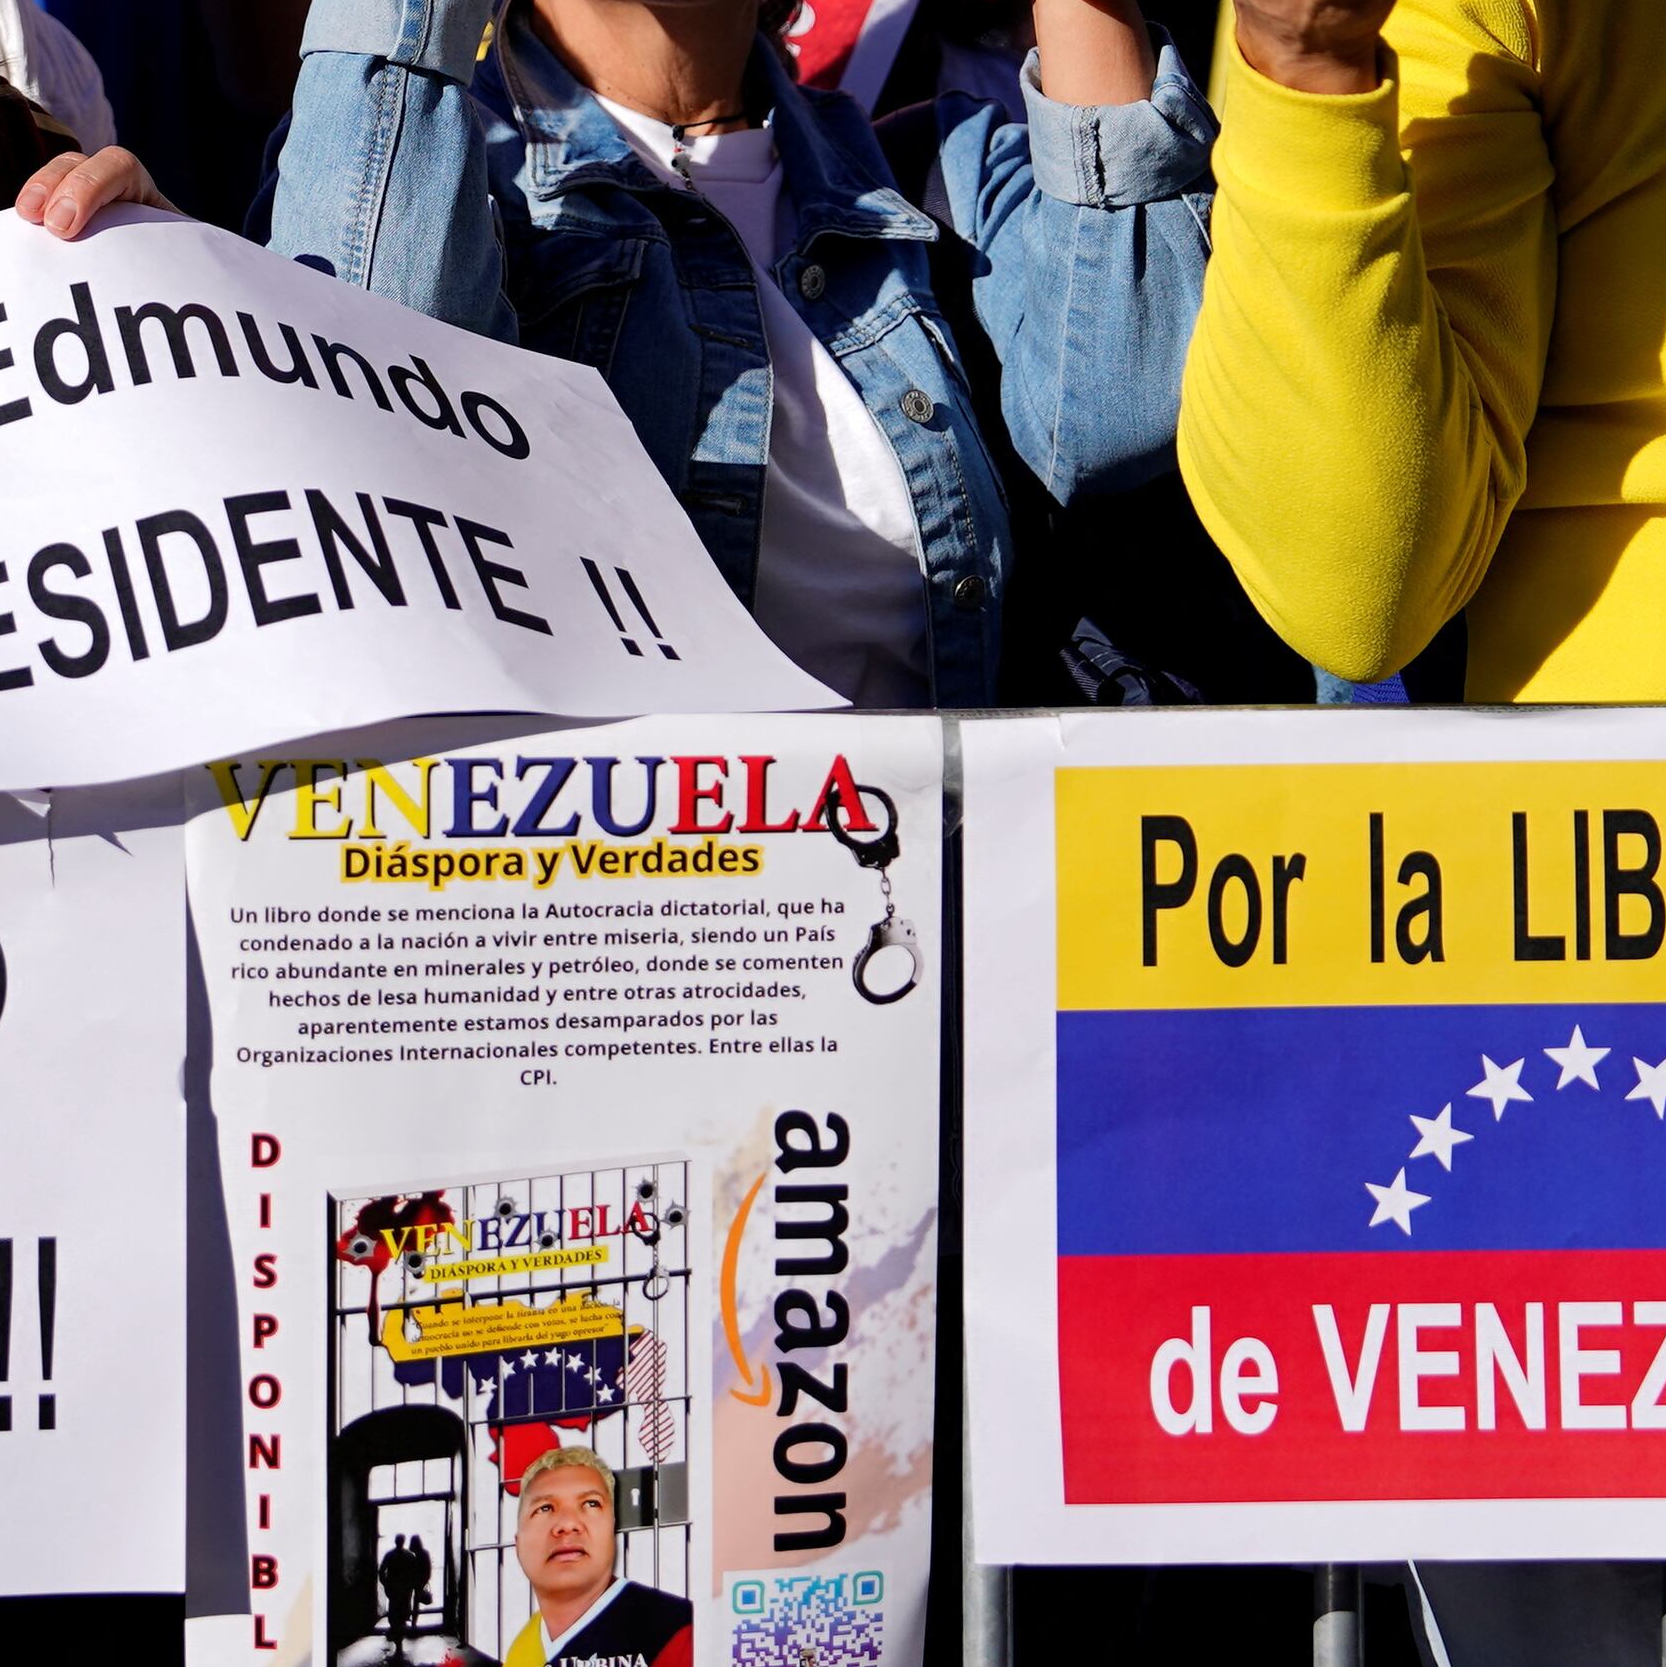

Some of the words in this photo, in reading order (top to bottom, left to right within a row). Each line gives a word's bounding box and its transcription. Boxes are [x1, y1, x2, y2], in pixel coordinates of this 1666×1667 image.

[205, 752, 880, 841] VENEZUELA
[343, 841, 524, 886] Diáspora
[536, 851, 560, 884] y
[571, 841, 760, 875] Verdades
[1139, 813, 1306, 968] Por
[1370, 811, 1444, 965] la
[231, 908, 257, 923] Un
[265, 907, 311, 923] libro
[318, 906, 381, 922] donde
[388, 909, 409, 921] se
[416, 904, 514, 921] menciona
[522, 903, 538, 919] la
[545, 901, 653, 918] Autocracia
[661, 899, 770, 917] dictatorial,
[778, 902, 814, 919] que
[821, 898, 844, 914] ha
[380, 1202, 654, 1260] VENEZUELA
[523, 1248, 603, 1268] VERDADES
[773, 1109, 851, 1552] amazon
[1148, 1305, 1280, 1437] de
